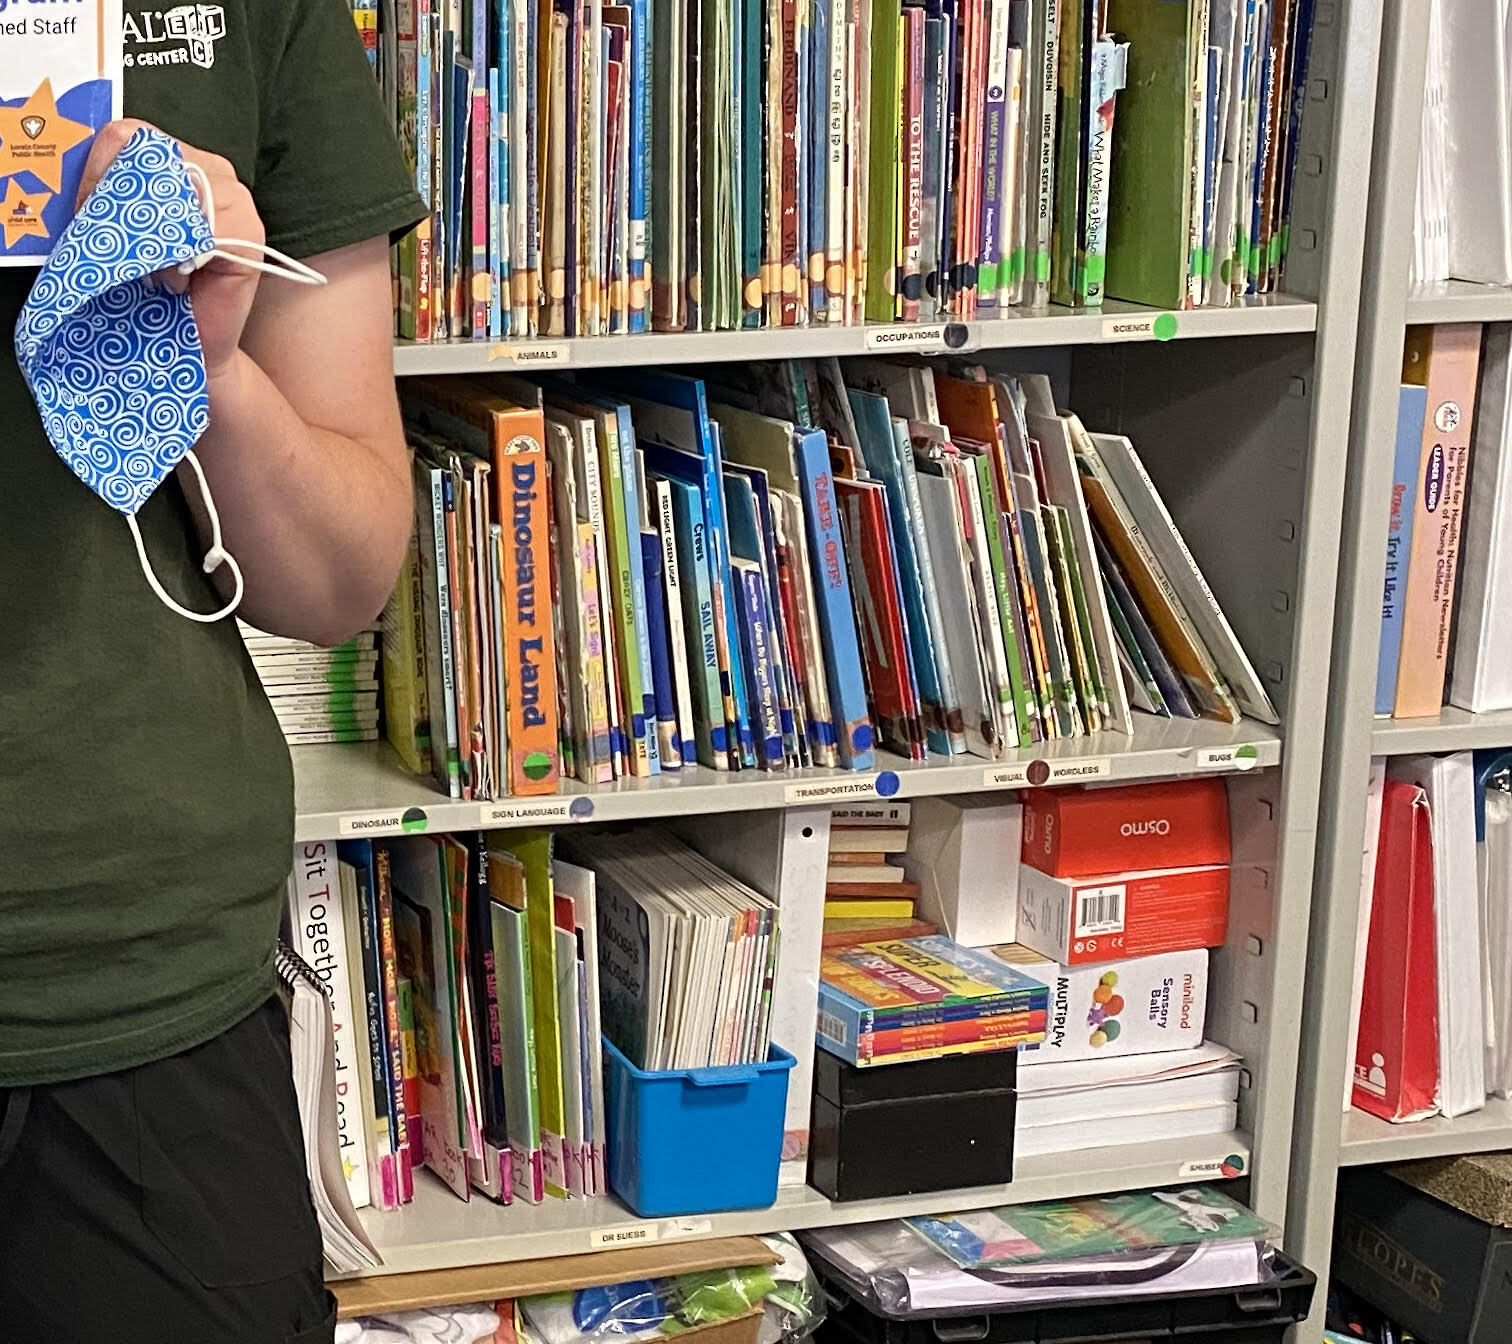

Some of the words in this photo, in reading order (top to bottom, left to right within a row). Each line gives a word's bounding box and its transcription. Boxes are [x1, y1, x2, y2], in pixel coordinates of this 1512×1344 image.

[33, 17, 77, 35] Staff
[122, 12, 166, 43] AL
[138, 48, 188, 66] CENTER
[911, 115, 920, 132] TO
[1043, 113, 1051, 139] HIDE
[910, 135, 921, 169] THE
[1042, 142, 1051, 163] AND
[1041, 166, 1050, 193] SEEK
[907, 171, 921, 240] RESCUE
[1040, 196, 1048, 219] FOG
[876, 330, 940, 343] OCCUPATIONS
[1113, 323, 1151, 334] SCIENCE
[517, 350, 558, 361] ANIMALS
[510, 461, 537, 626] Dinosaur
[700, 600, 710, 633] SAIL
[704, 634, 717, 668] AWAY
[519, 636, 546, 729] Land
[1208, 752, 1232, 762] BUGS
[994, 772, 1024, 782] VISUAL
[1053, 765, 1099, 777] WORDLESS
[796, 782, 874, 797] TRANSPORTATION
[492, 810, 514, 818] SIGN
[516, 807, 566, 817] LANGUAGE
[352, 817, 399, 830] DINOSAUR
[1044, 814, 1054, 854] Osmo
[1121, 819, 1170, 837] Osmo
[1149, 989, 1161, 1020] Balls
[1160, 977, 1173, 1029] Sensory
[1181, 973, 1192, 1029] miniland
[602, 1233, 613, 1242] DR
